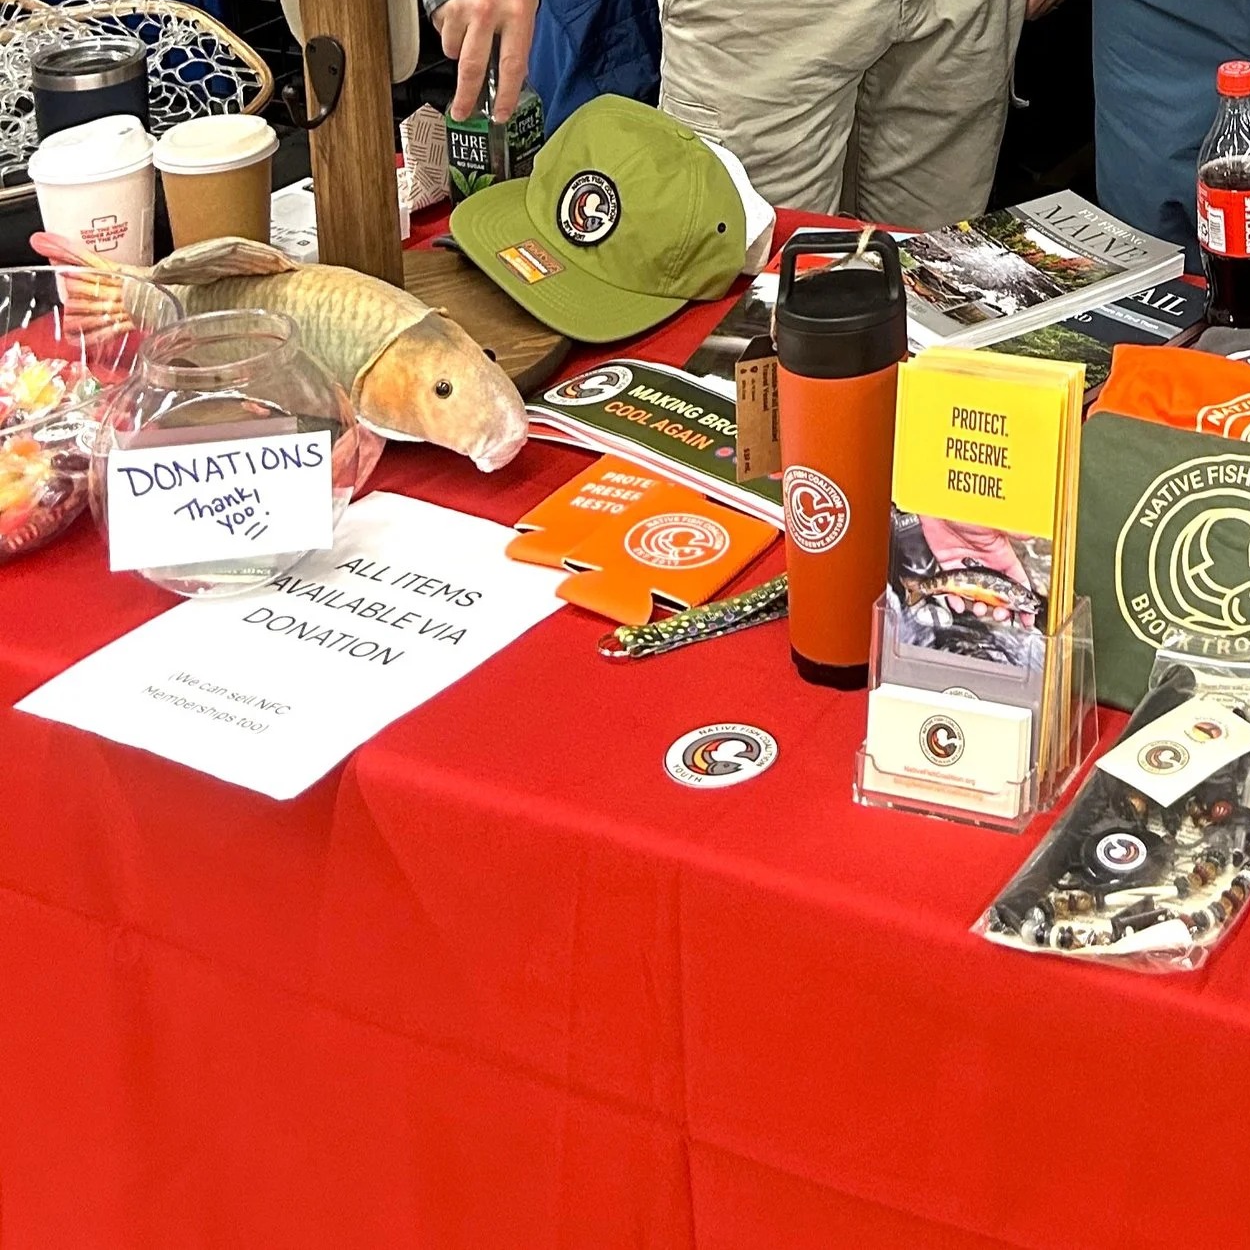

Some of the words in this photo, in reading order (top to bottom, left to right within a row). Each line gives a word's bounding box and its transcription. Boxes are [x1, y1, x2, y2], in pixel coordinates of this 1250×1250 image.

[451, 132, 487, 150] PURE
[452, 146, 488, 162] LEAF
[467, 162, 484, 170] SUGAR
[572, 176, 590, 190] NATIVE
[591, 176, 604, 186] FISH
[604, 184, 617, 222] COALITION
[1035, 204, 1148, 263] MAINE
[1078, 208, 1098, 224] FLY
[1098, 219, 1147, 246] FISHING
[1126, 313, 1139, 324] Find
[1141, 319, 1159, 330] Them
[628, 384, 703, 420] MAKING
[604, 401, 649, 426] COOL
[651, 418, 714, 450] AGAIN
[952, 406, 1009, 438] PROTECT.
[117, 443, 323, 497] DONATIONS
[946, 437, 1011, 470] PRESERVE.
[808, 473, 843, 508] COALITION
[948, 468, 1006, 500] RESTORE.
[1139, 469, 1204, 528] NATIVE
[173, 486, 253, 521] Thank
[334, 558, 391, 582] ALL
[390, 571, 483, 607] ITEMS
[264, 575, 422, 629] AVAILABLE
[418, 618, 468, 645] VIA
[242, 607, 405, 666] DONATION
[142, 685, 237, 723] Memberships
[199, 682, 228, 696] can
[227, 691, 257, 705] sell
[254, 698, 291, 715] NFC
[698, 726, 737, 736] NATIVE
[740, 727, 760, 736] FISH
[673, 763, 702, 782] YOUTH
